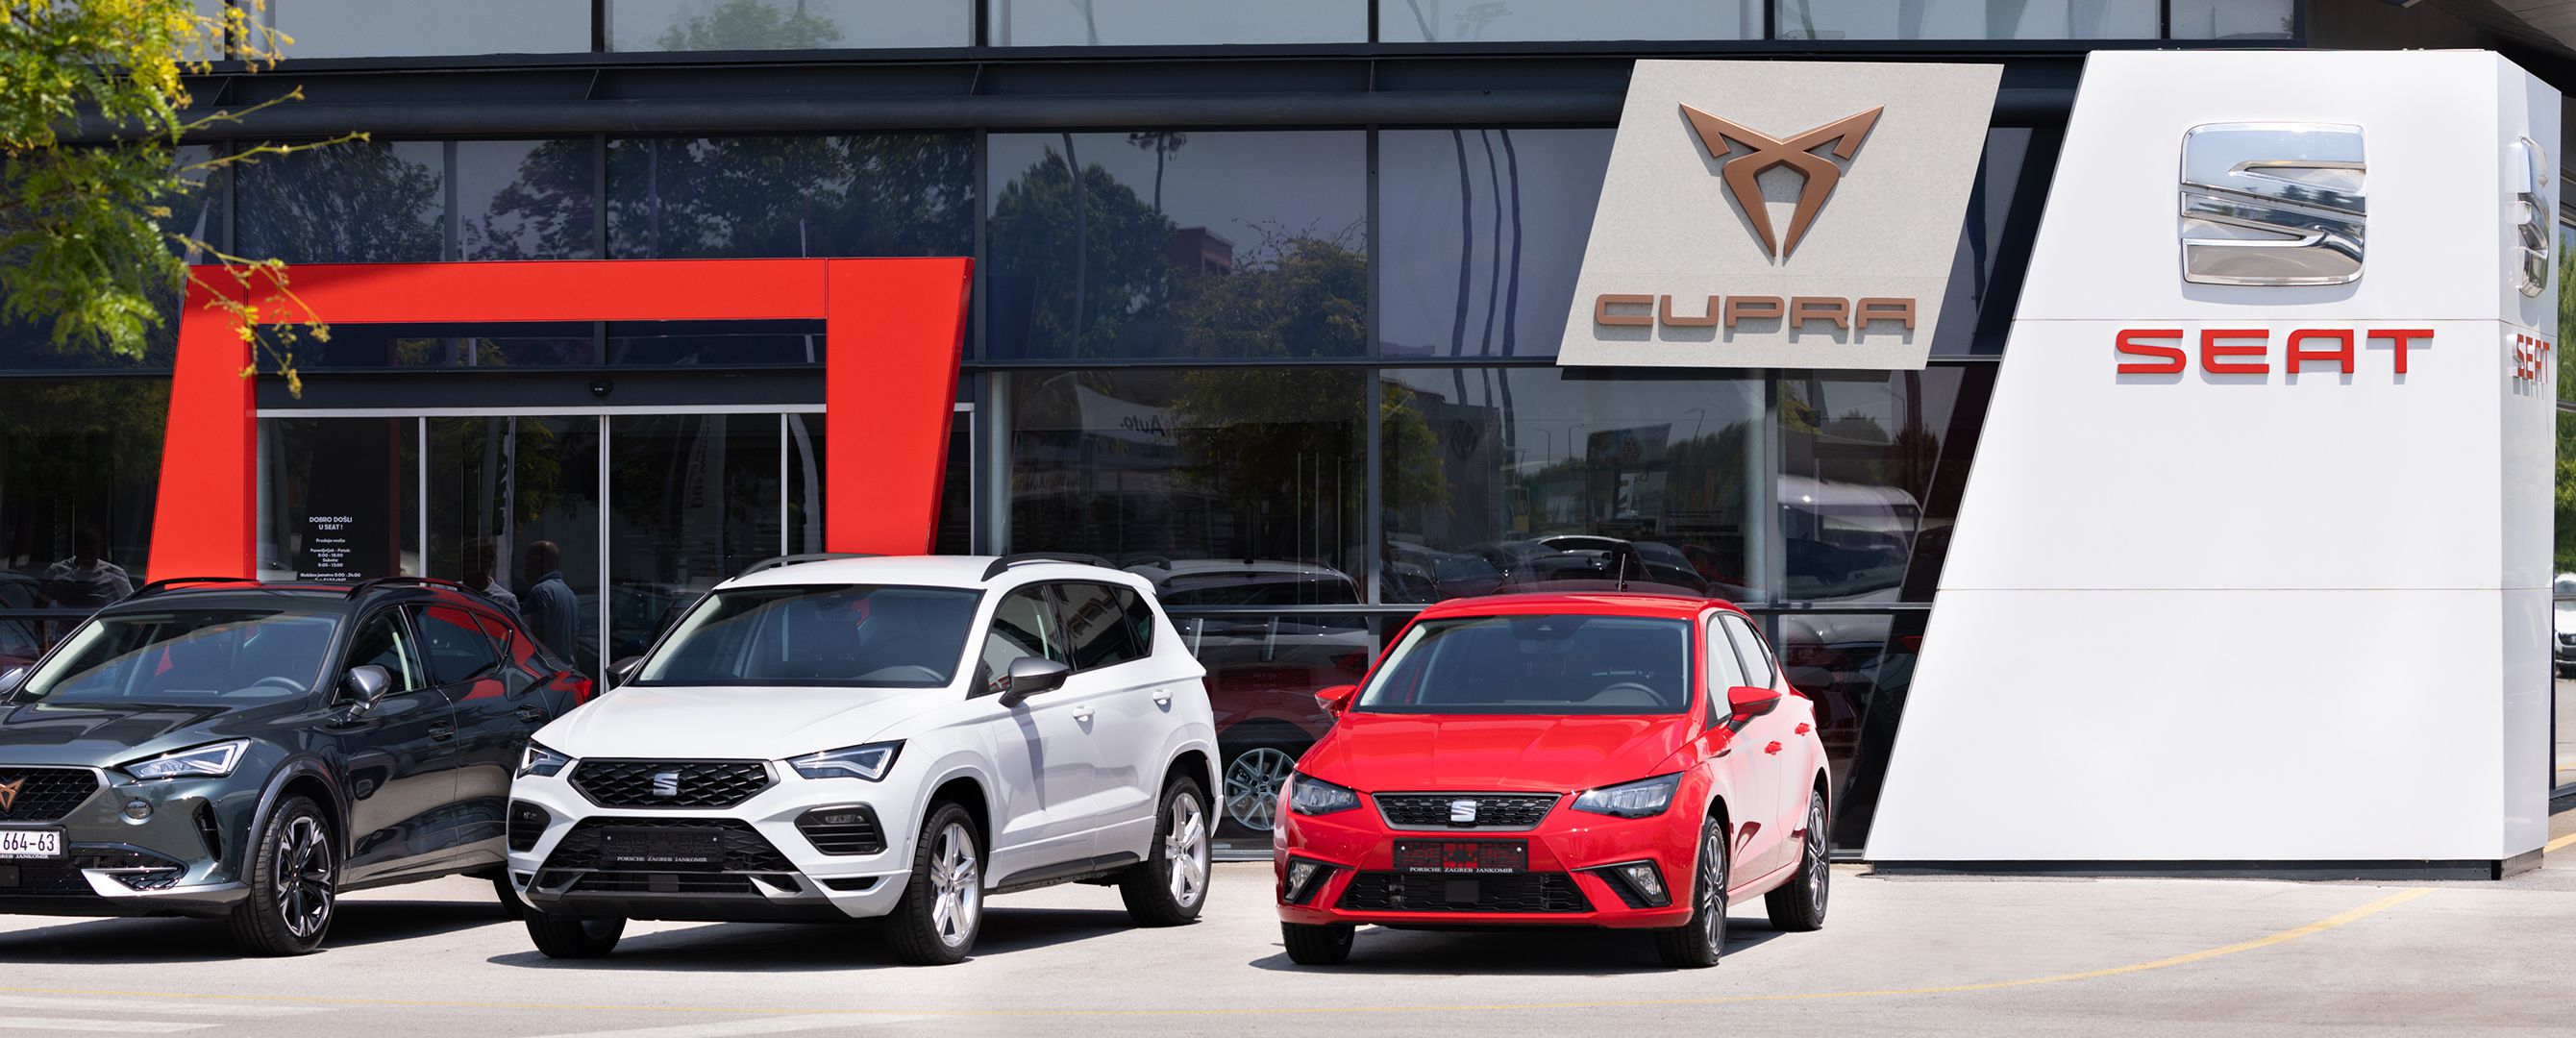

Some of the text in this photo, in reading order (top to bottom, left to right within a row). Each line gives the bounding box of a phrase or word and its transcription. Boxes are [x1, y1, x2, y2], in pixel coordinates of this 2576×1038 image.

[1595, 294, 1916, 330] CUPRA
[2115, 329, 2435, 375] SEAT
[2515, 334, 2550, 384] SEAT
[3, 832, 55, 852] 664-63
